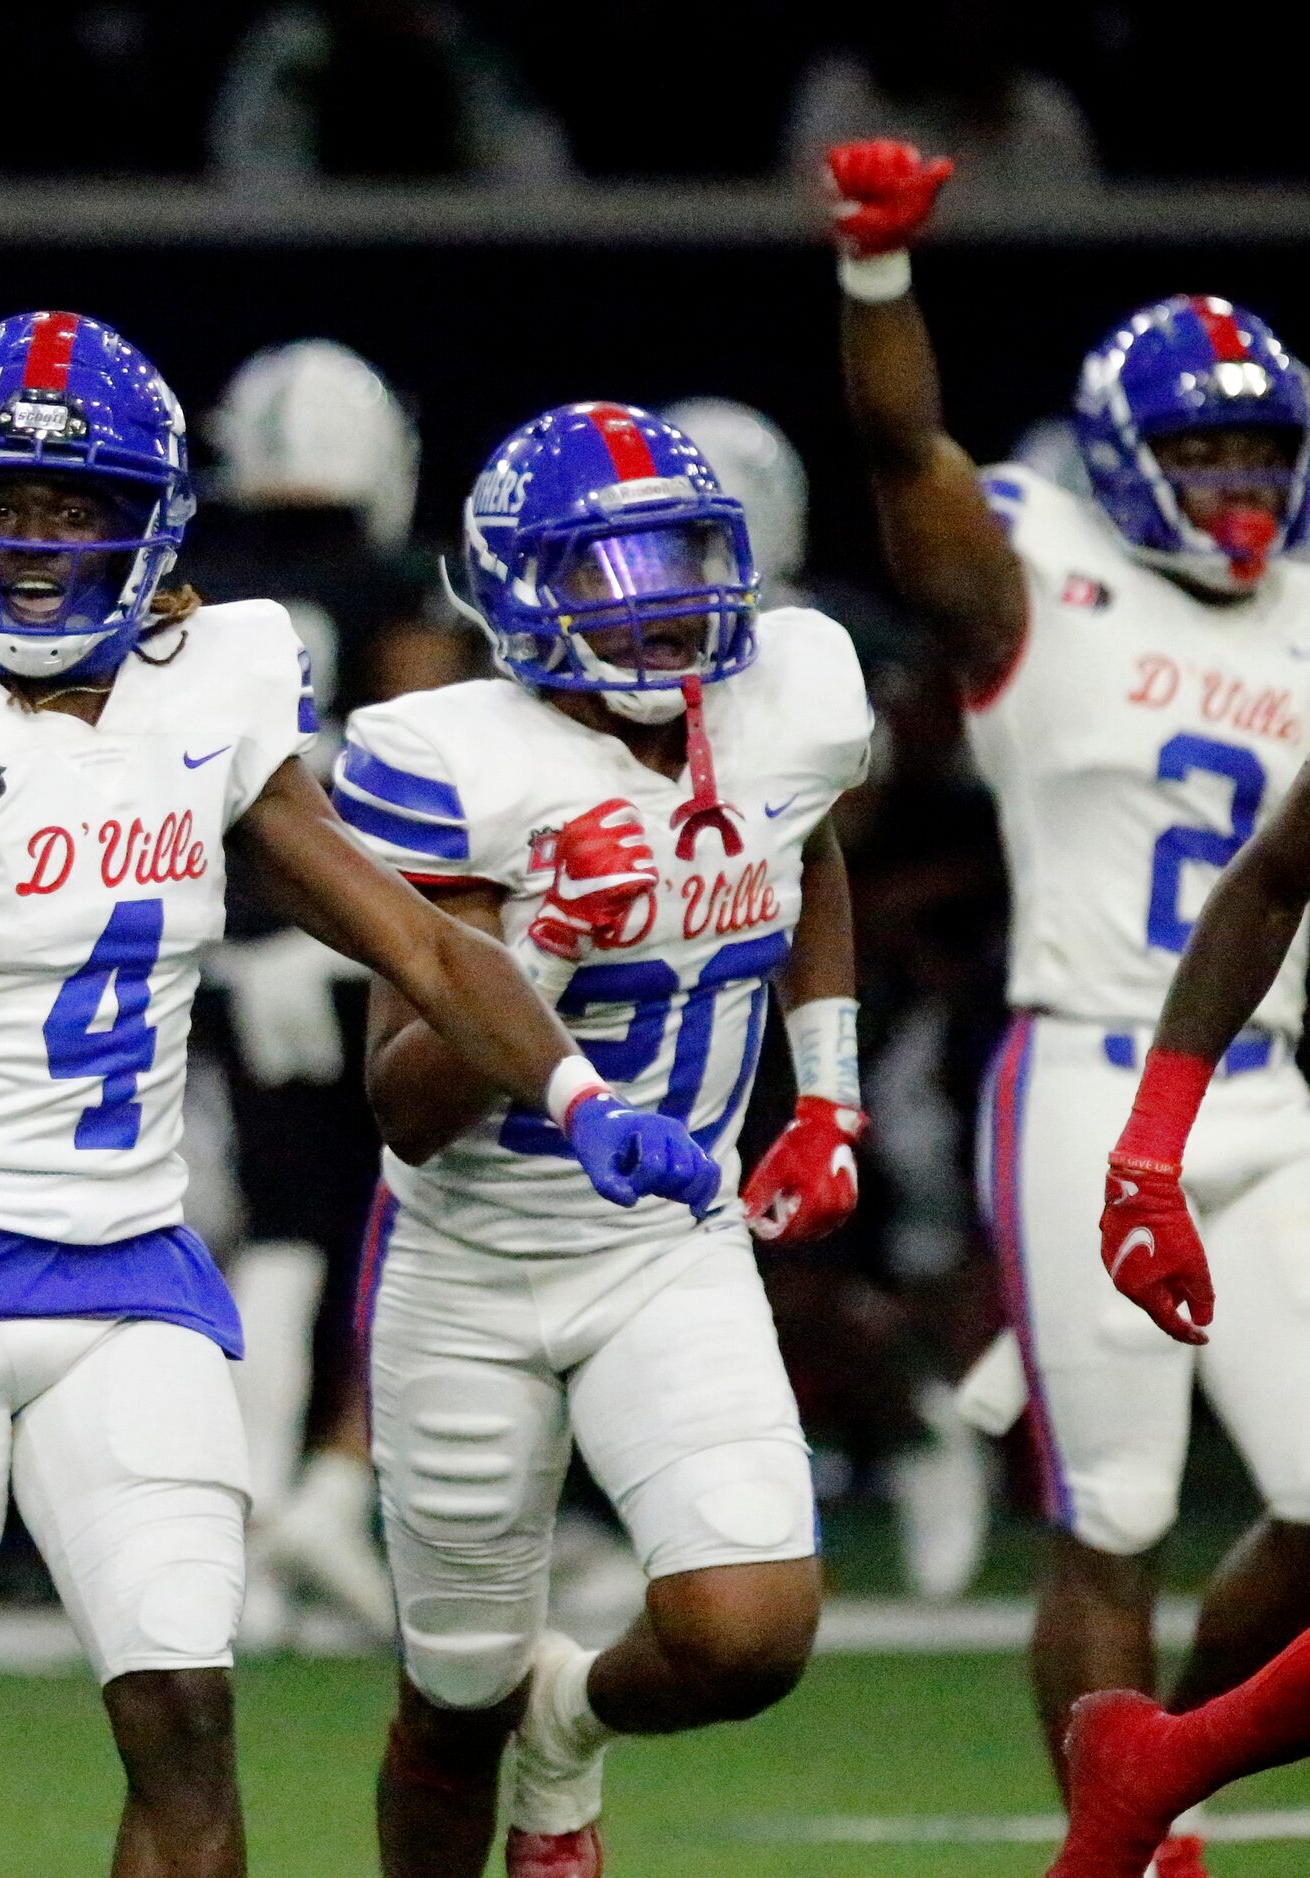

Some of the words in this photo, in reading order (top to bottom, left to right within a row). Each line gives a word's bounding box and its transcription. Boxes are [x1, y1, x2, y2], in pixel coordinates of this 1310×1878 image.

[15, 808, 208, 897] D'Ville
[1147, 733, 1266, 953] 2
[42, 898, 165, 1150] 4
[497, 930, 793, 1160] 20
